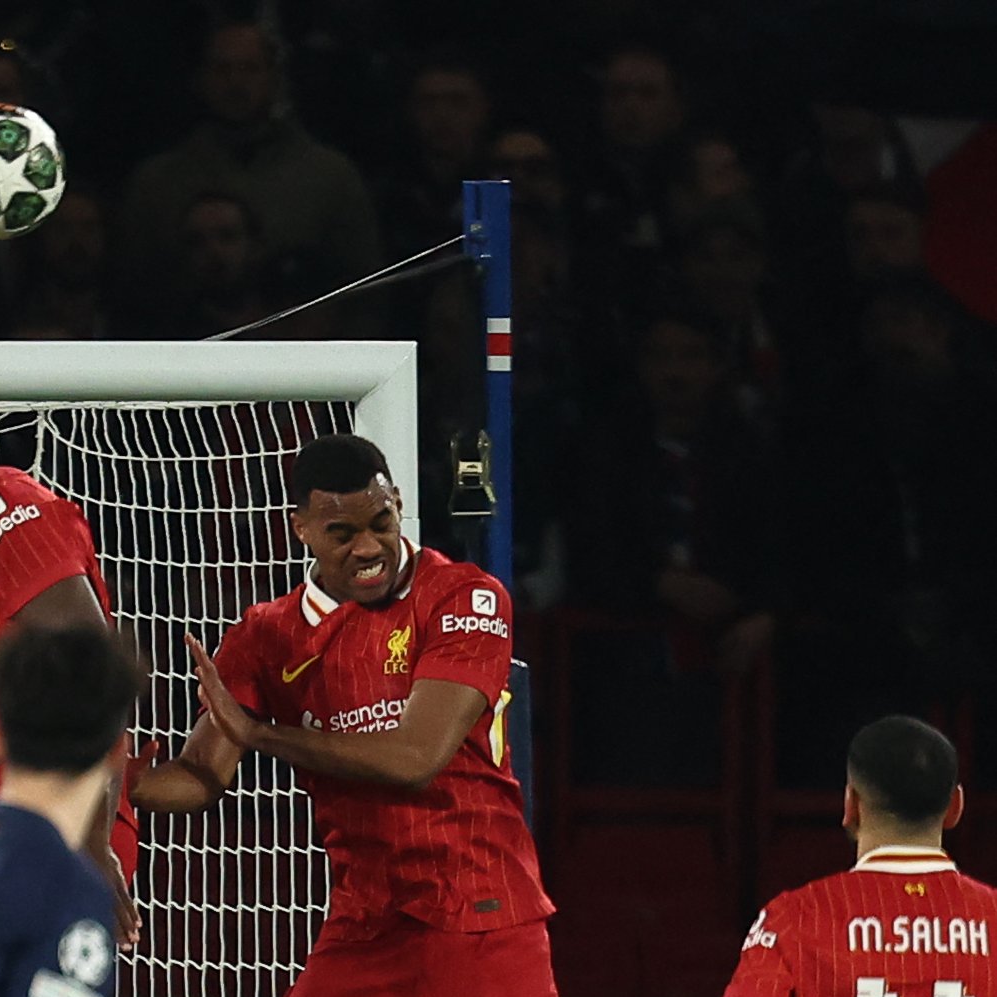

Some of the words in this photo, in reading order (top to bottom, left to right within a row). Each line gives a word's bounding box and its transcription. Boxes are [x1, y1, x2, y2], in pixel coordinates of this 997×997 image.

[441, 613, 509, 639] Expedia
[384, 662, 409, 675] LFC
[329, 698, 408, 732] standa
[848, 914, 990, 957] M.SALAH
